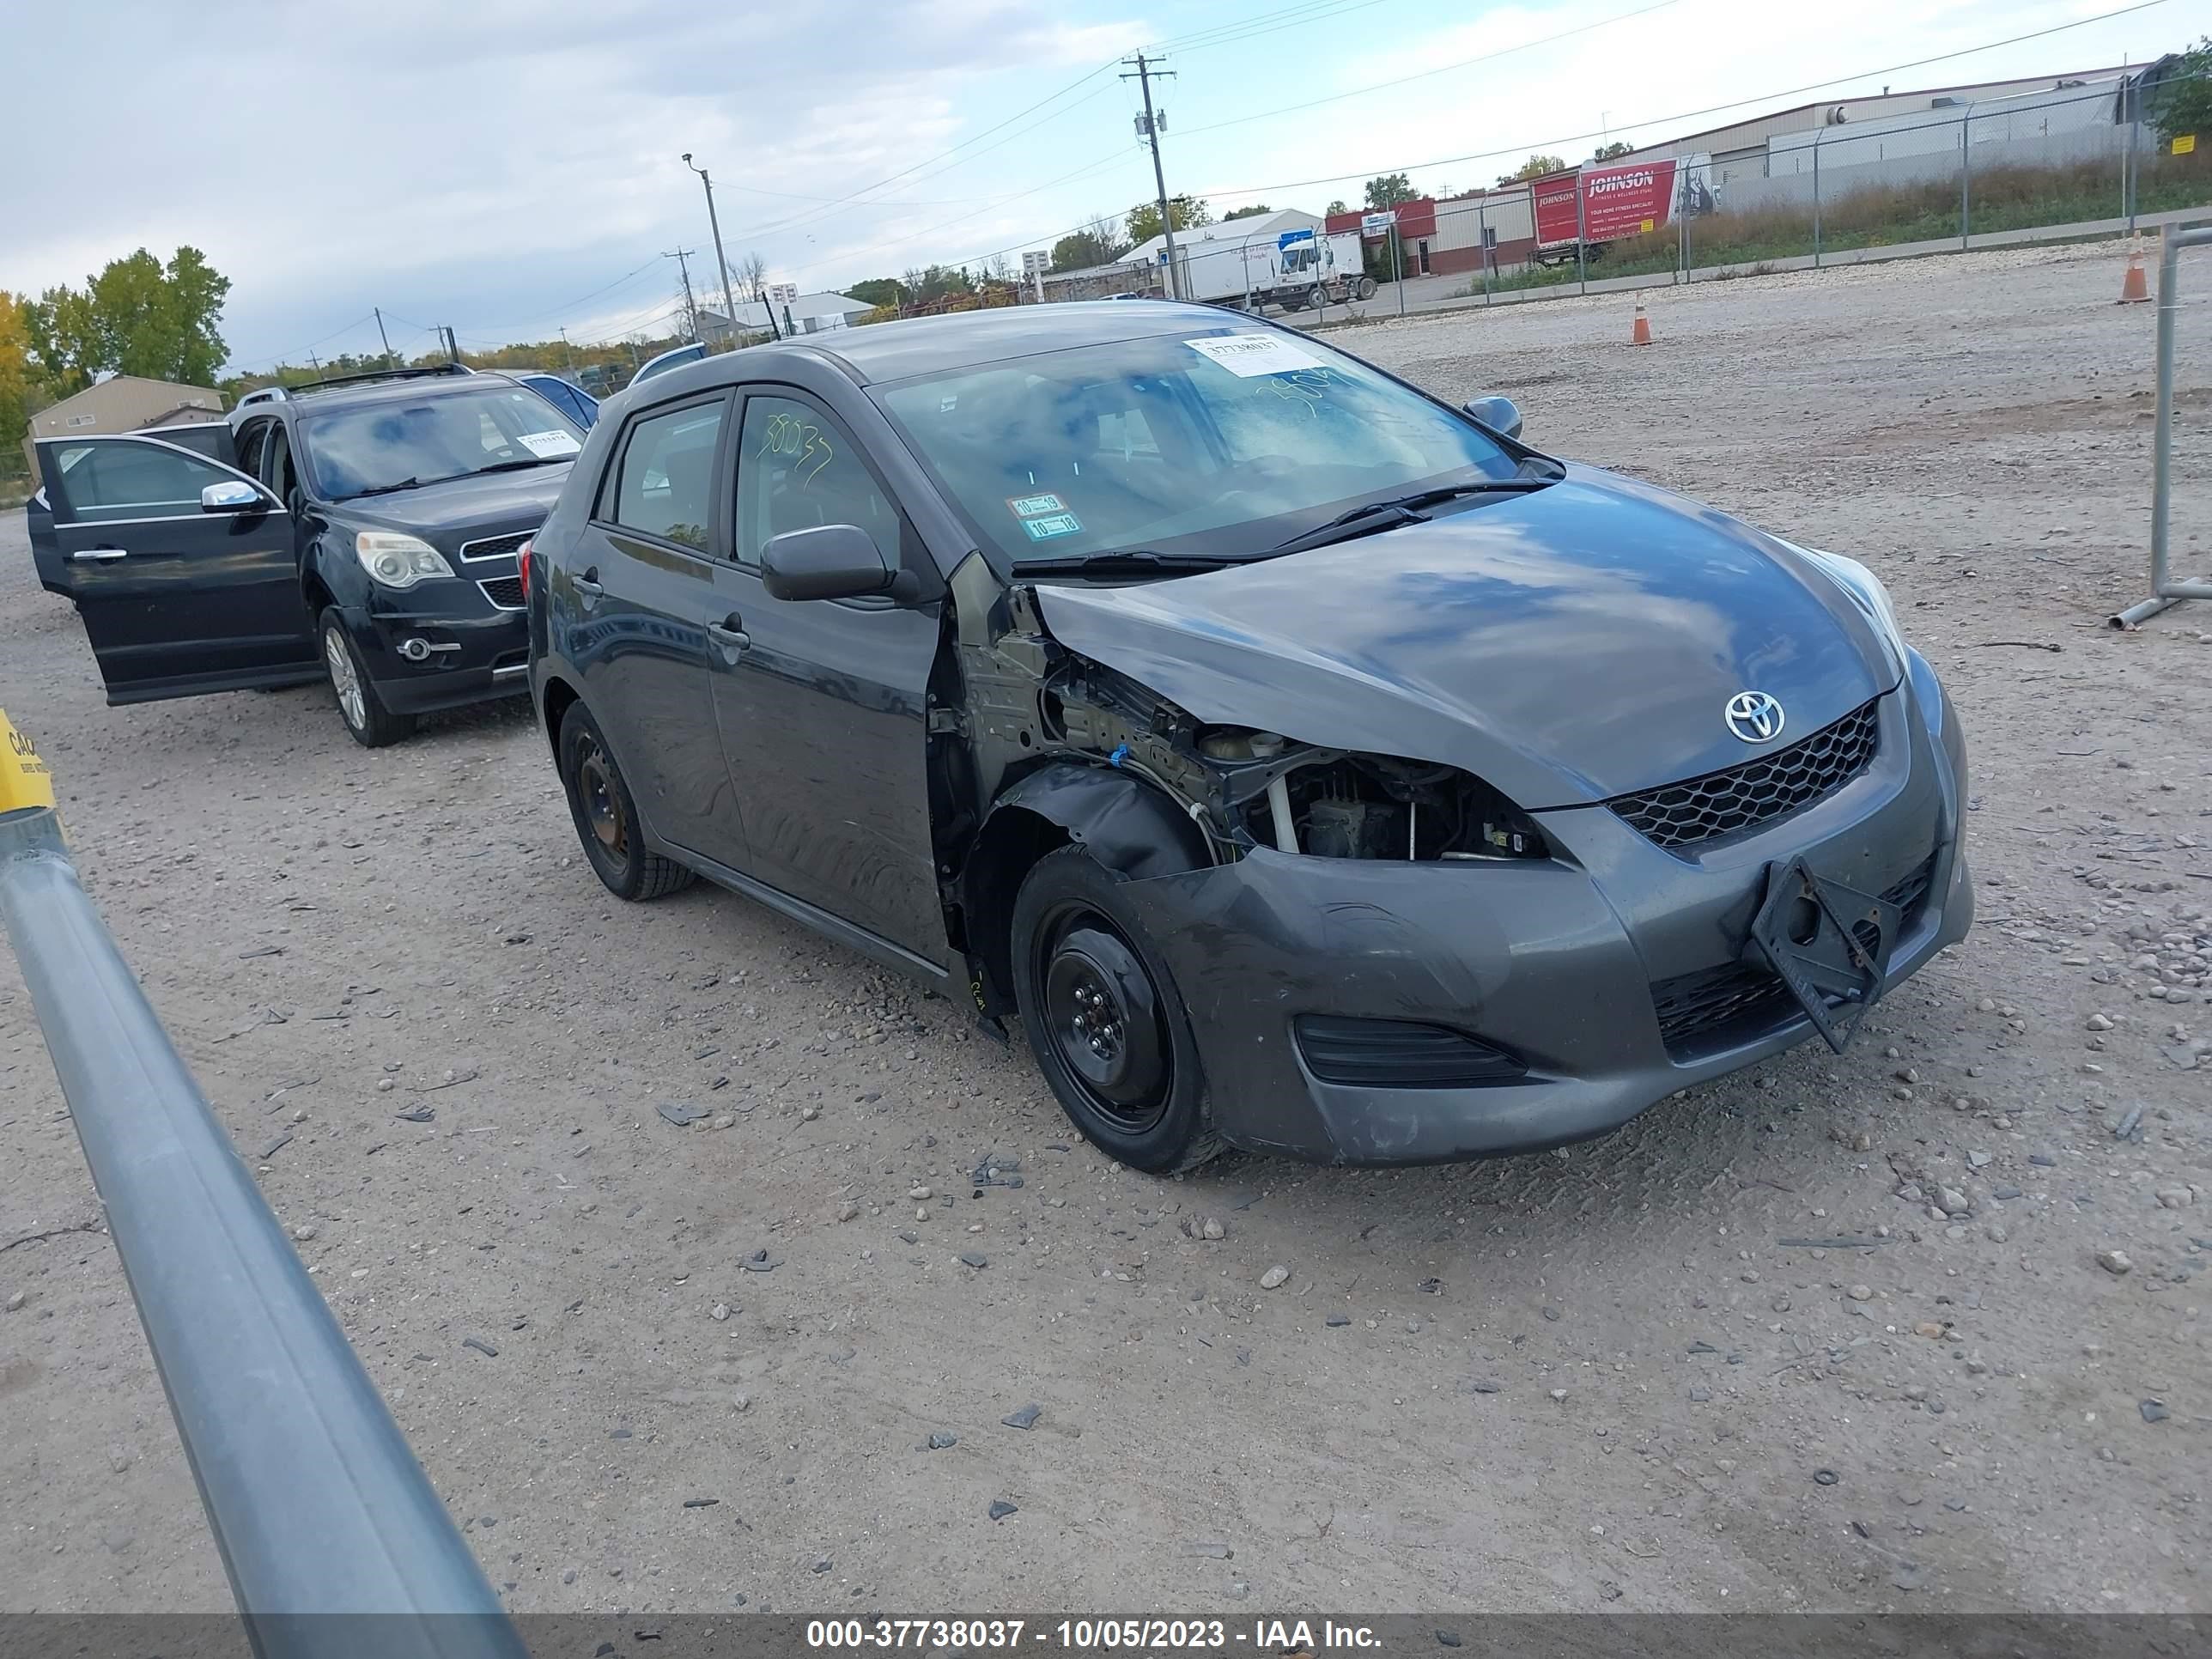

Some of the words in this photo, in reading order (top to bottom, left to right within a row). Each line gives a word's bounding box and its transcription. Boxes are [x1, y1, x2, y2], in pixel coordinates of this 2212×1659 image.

[1589, 171, 1653, 198] JOHNSON
[1539, 192, 1575, 207] JOHNSON
[1206, 341, 1279, 355] 37738037
[1018, 501, 1031, 514] 10
[1043, 496, 1058, 509] 19
[1032, 522, 1048, 535] 10
[1060, 517, 1076, 530] 18
